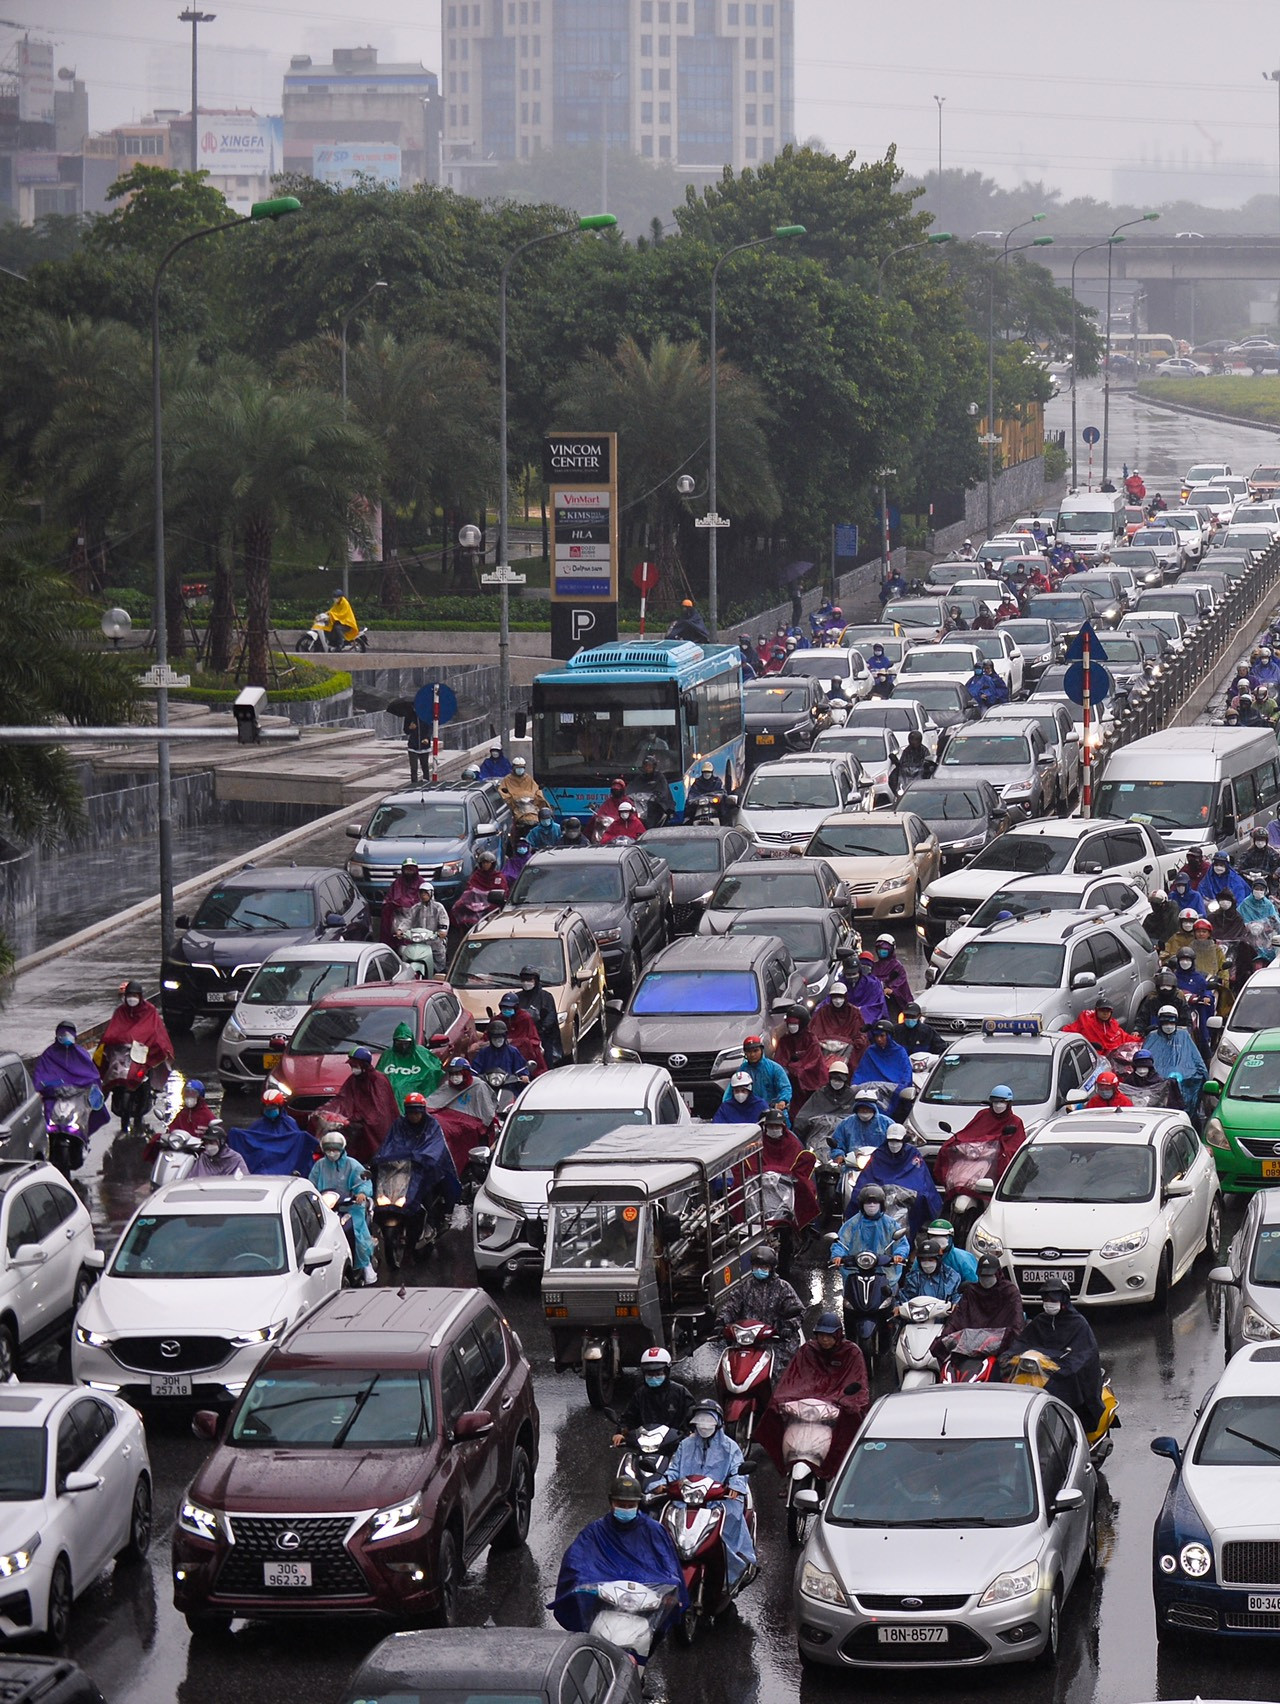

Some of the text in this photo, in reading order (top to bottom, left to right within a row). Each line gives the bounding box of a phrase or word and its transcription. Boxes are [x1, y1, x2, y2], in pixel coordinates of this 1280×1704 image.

[220, 135, 264, 147] XINGFA
[550, 444, 602, 456] VINCOM
[551, 456, 600, 468] CENTER
[563, 494, 600, 505] VinMart
[567, 511, 591, 519] KIMS
[571, 530, 593, 539] HLA
[571, 609, 596, 641] P
[384, 1063, 422, 1075] Grab
[155, 1385, 188, 1395] 257.18
[277, 1563, 298, 1575] 30G
[269, 1574, 307, 1586] 962.32
[883, 1628, 944, 1642] 18N-8577
